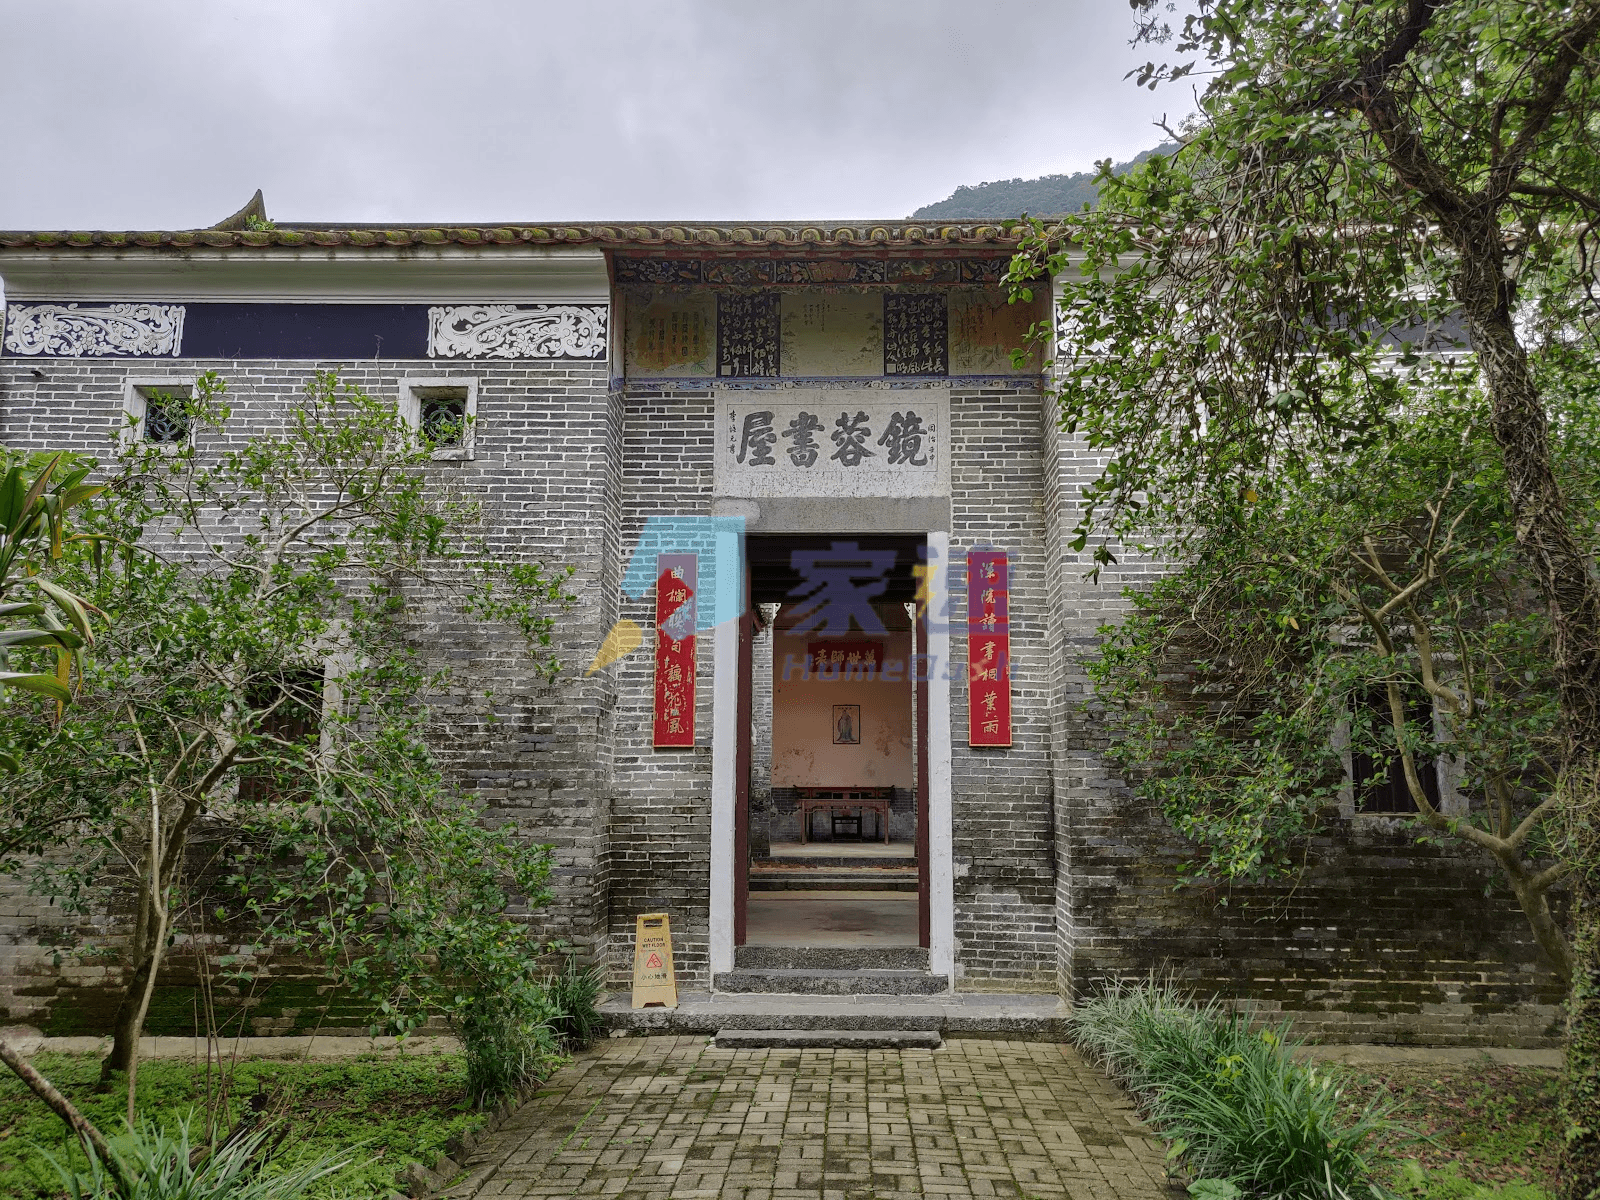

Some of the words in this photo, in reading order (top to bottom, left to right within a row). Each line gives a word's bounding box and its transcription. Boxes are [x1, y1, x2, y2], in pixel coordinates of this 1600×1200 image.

[736, 411, 928, 468] 鏡蓉書屋
[815, 648, 876, 666] 萬世師表
[979, 561, 1000, 735] 深院讀書桐葉雨
